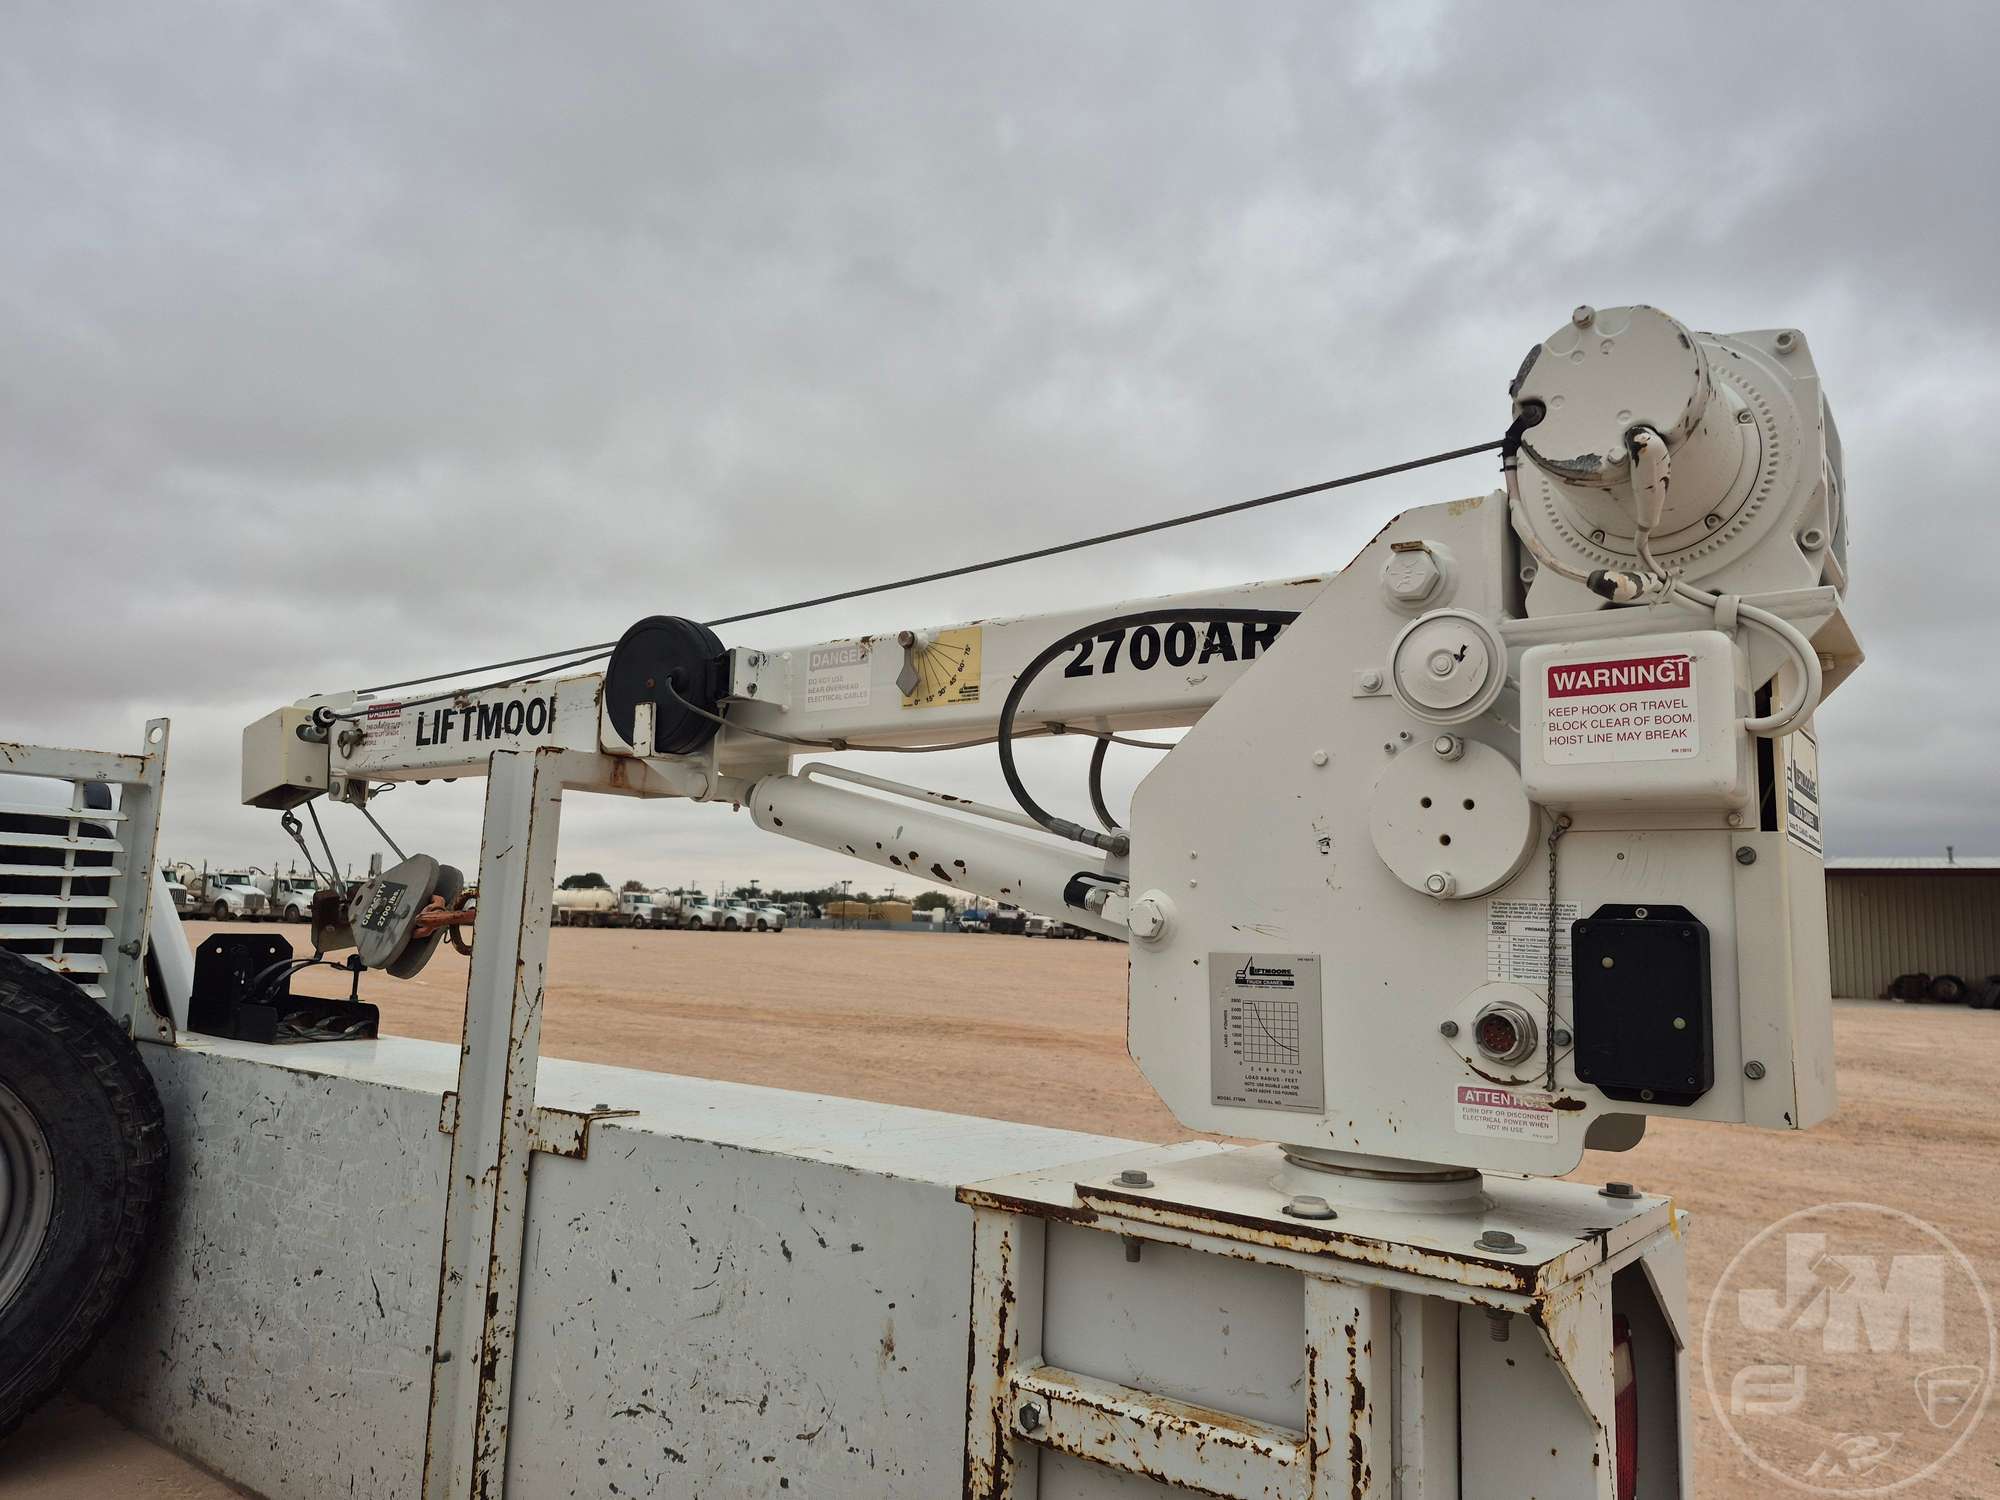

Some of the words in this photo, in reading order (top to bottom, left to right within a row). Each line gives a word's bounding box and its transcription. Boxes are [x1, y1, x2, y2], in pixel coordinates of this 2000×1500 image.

[1064, 621, 1283, 678] 2700AR
[1552, 661, 1685, 692] WARNING!
[1548, 705, 1579, 718] KEEP
[1581, 703, 1616, 715] HOOK
[1619, 701, 1638, 713] OR
[1640, 698, 1688, 711] TRAVEL
[1548, 719, 1588, 732] BLOCK
[1590, 717, 1631, 729] CLEAR
[1633, 715, 1652, 727] OF
[1654, 713, 1696, 725] BOOM.
[1549, 733, 1584, 745] HOIST
[1586, 731, 1613, 743] LINE
[1616, 730, 1642, 742] MAY
[1645, 728, 1687, 740] BREAK
[1465, 1089, 1552, 1109] ATTENT
[1462, 1114, 1501, 1124] ELECTRICAL
[1503, 1118, 1528, 1127] POWER
[1528, 1120, 1550, 1129] WHEN
[1507, 1111, 1550, 1121] DISCONNECT
